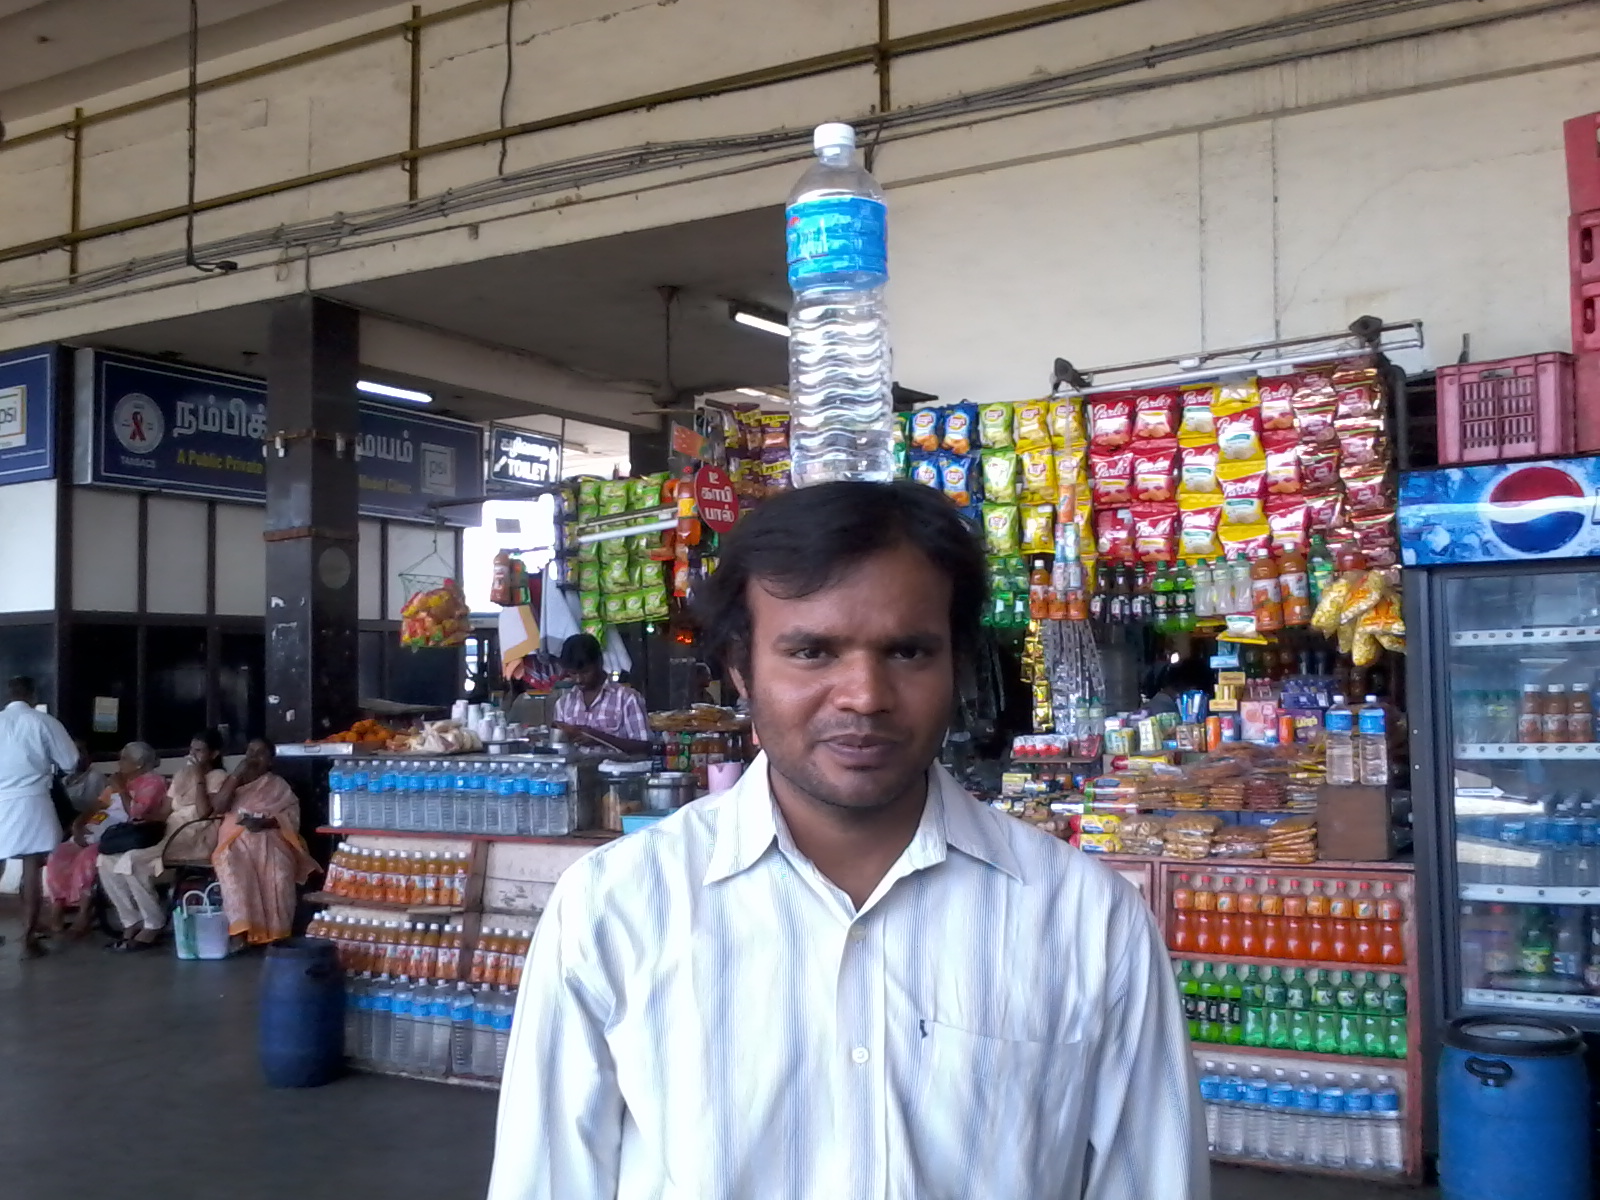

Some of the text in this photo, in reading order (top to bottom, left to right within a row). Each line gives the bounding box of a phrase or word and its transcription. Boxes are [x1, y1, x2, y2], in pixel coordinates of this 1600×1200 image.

[1135, 394, 1172, 412] Parle's
[1182, 390, 1213, 407] Parle
[173, 394, 268, 439] நம்பிக்
[1094, 402, 1130, 420] Parle's
[508, 458, 548, 482] TOILET
[1095, 457, 1131, 478] Parle's
[701, 485, 733, 503] காபி
[704, 503, 735, 523] பால்
